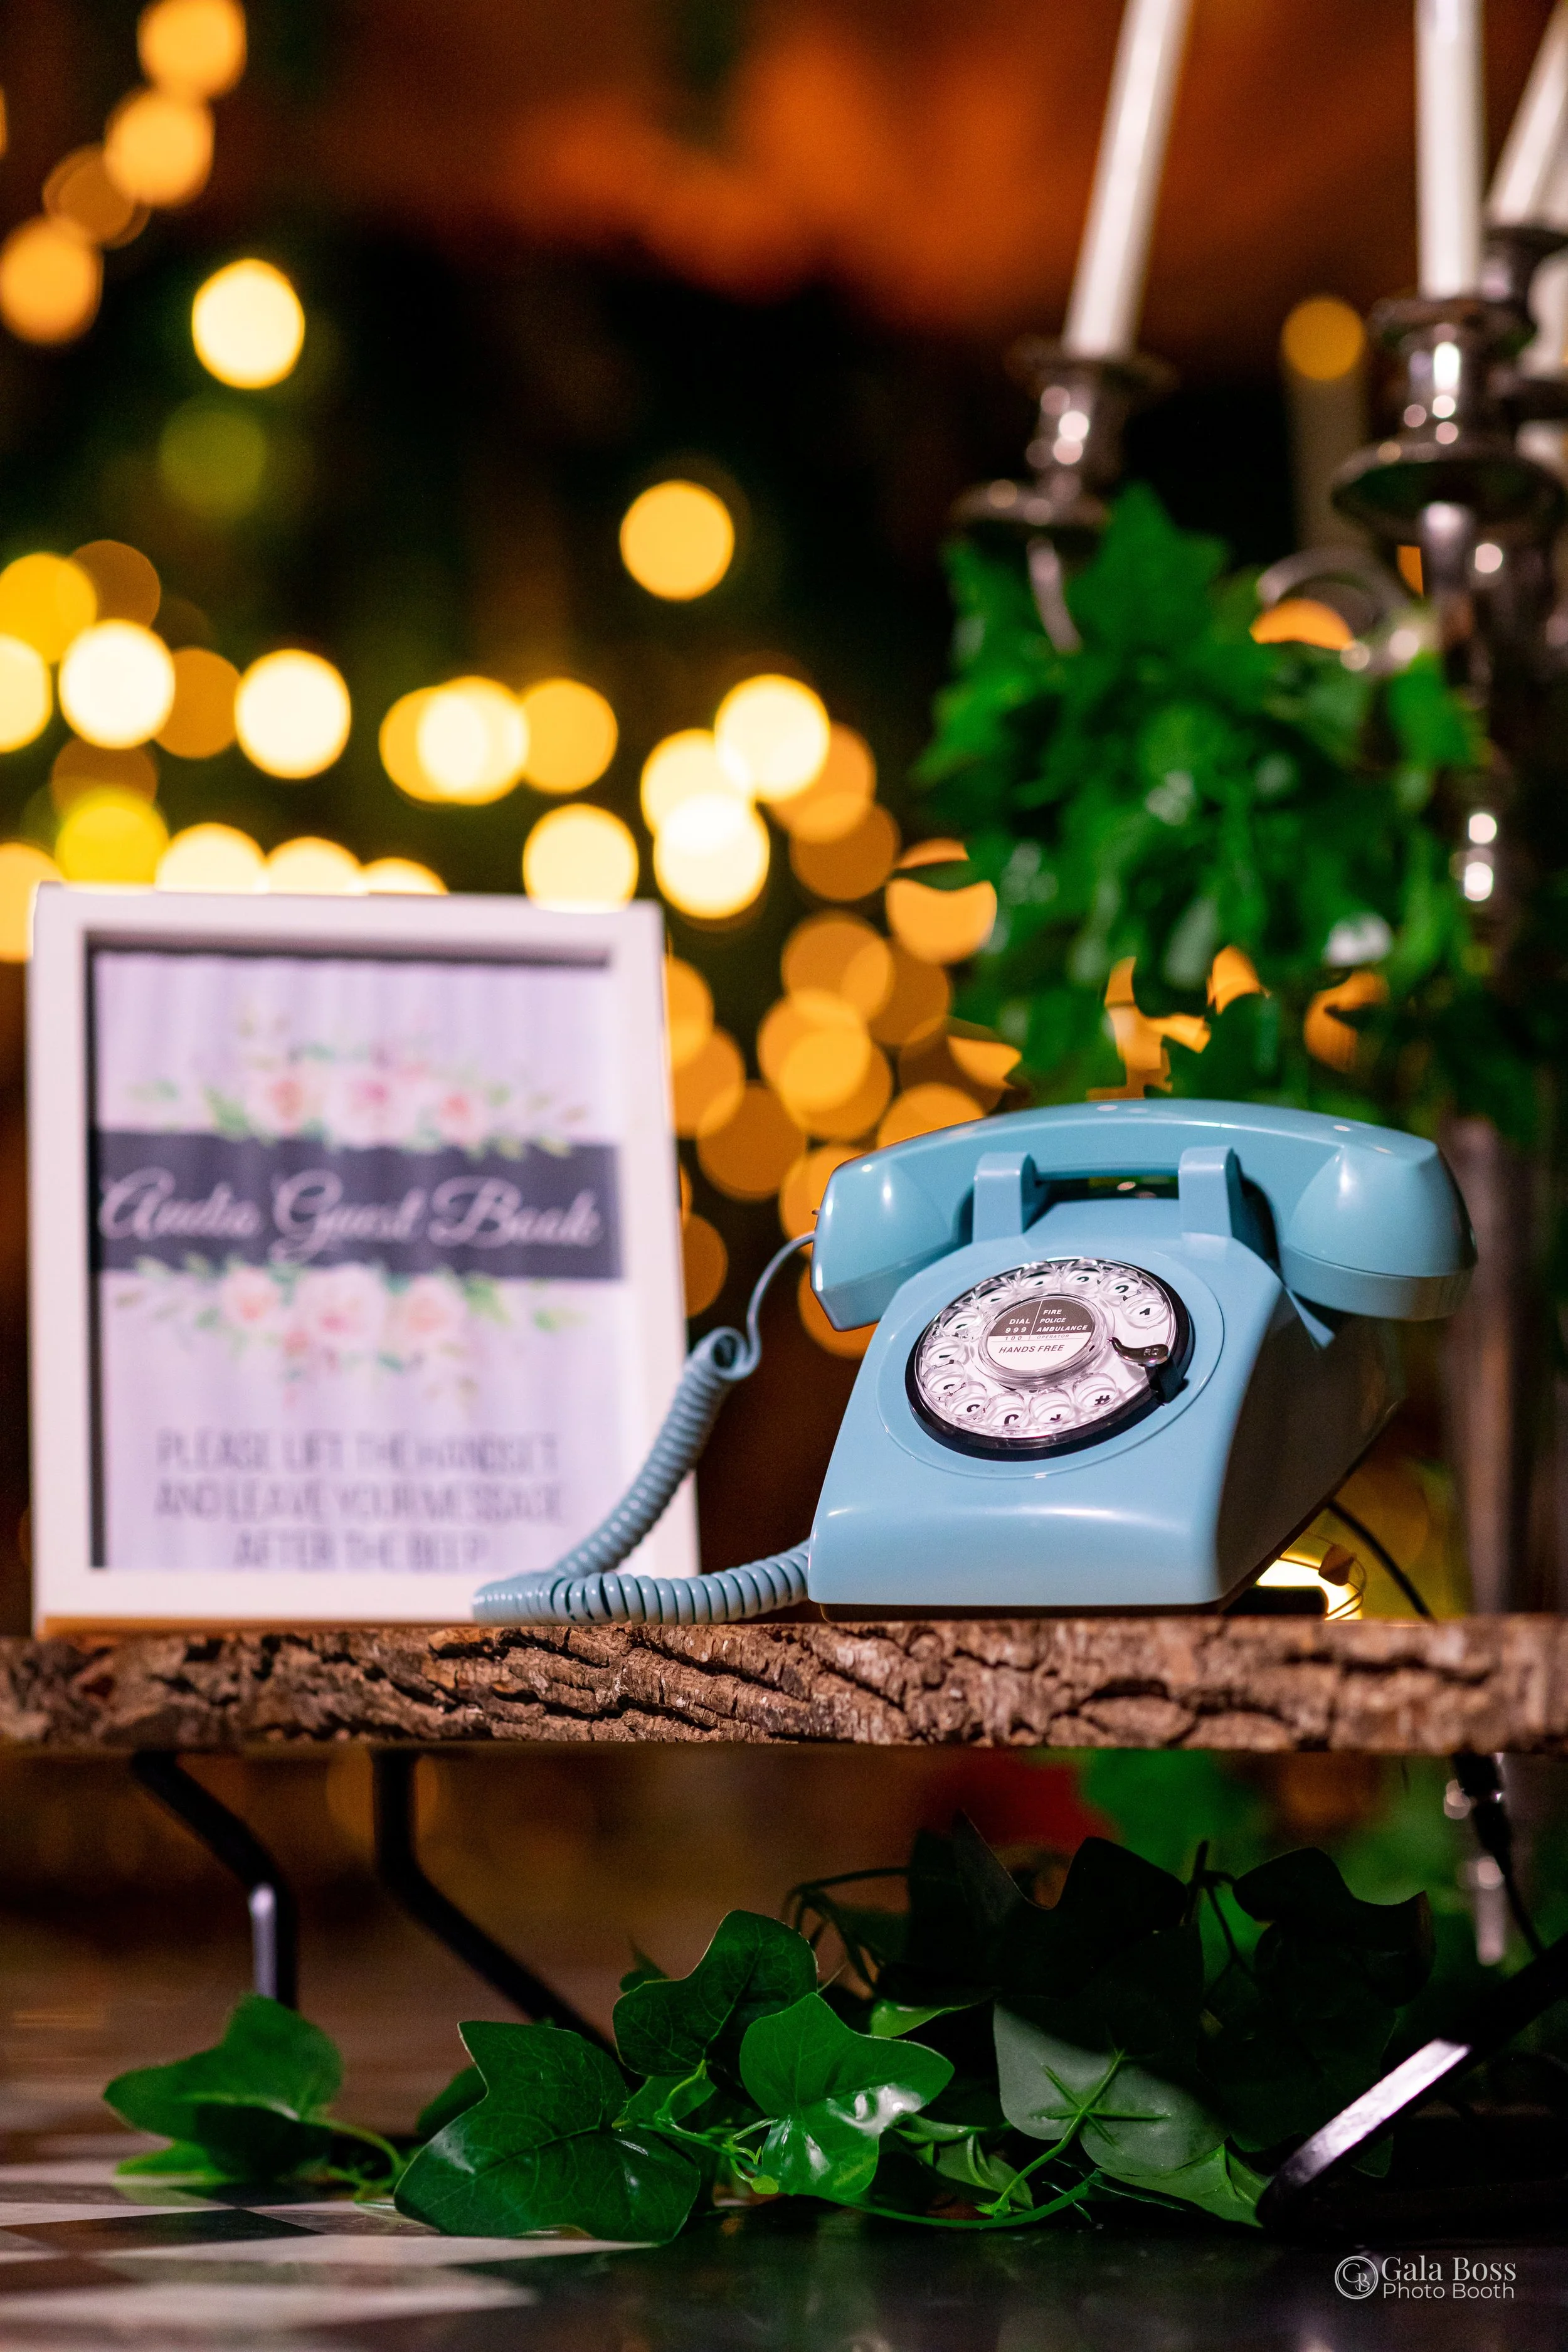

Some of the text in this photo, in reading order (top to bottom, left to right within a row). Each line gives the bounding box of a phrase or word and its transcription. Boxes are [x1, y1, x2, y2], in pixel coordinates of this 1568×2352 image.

[100, 1167, 602, 1263] Audio Guest Book
